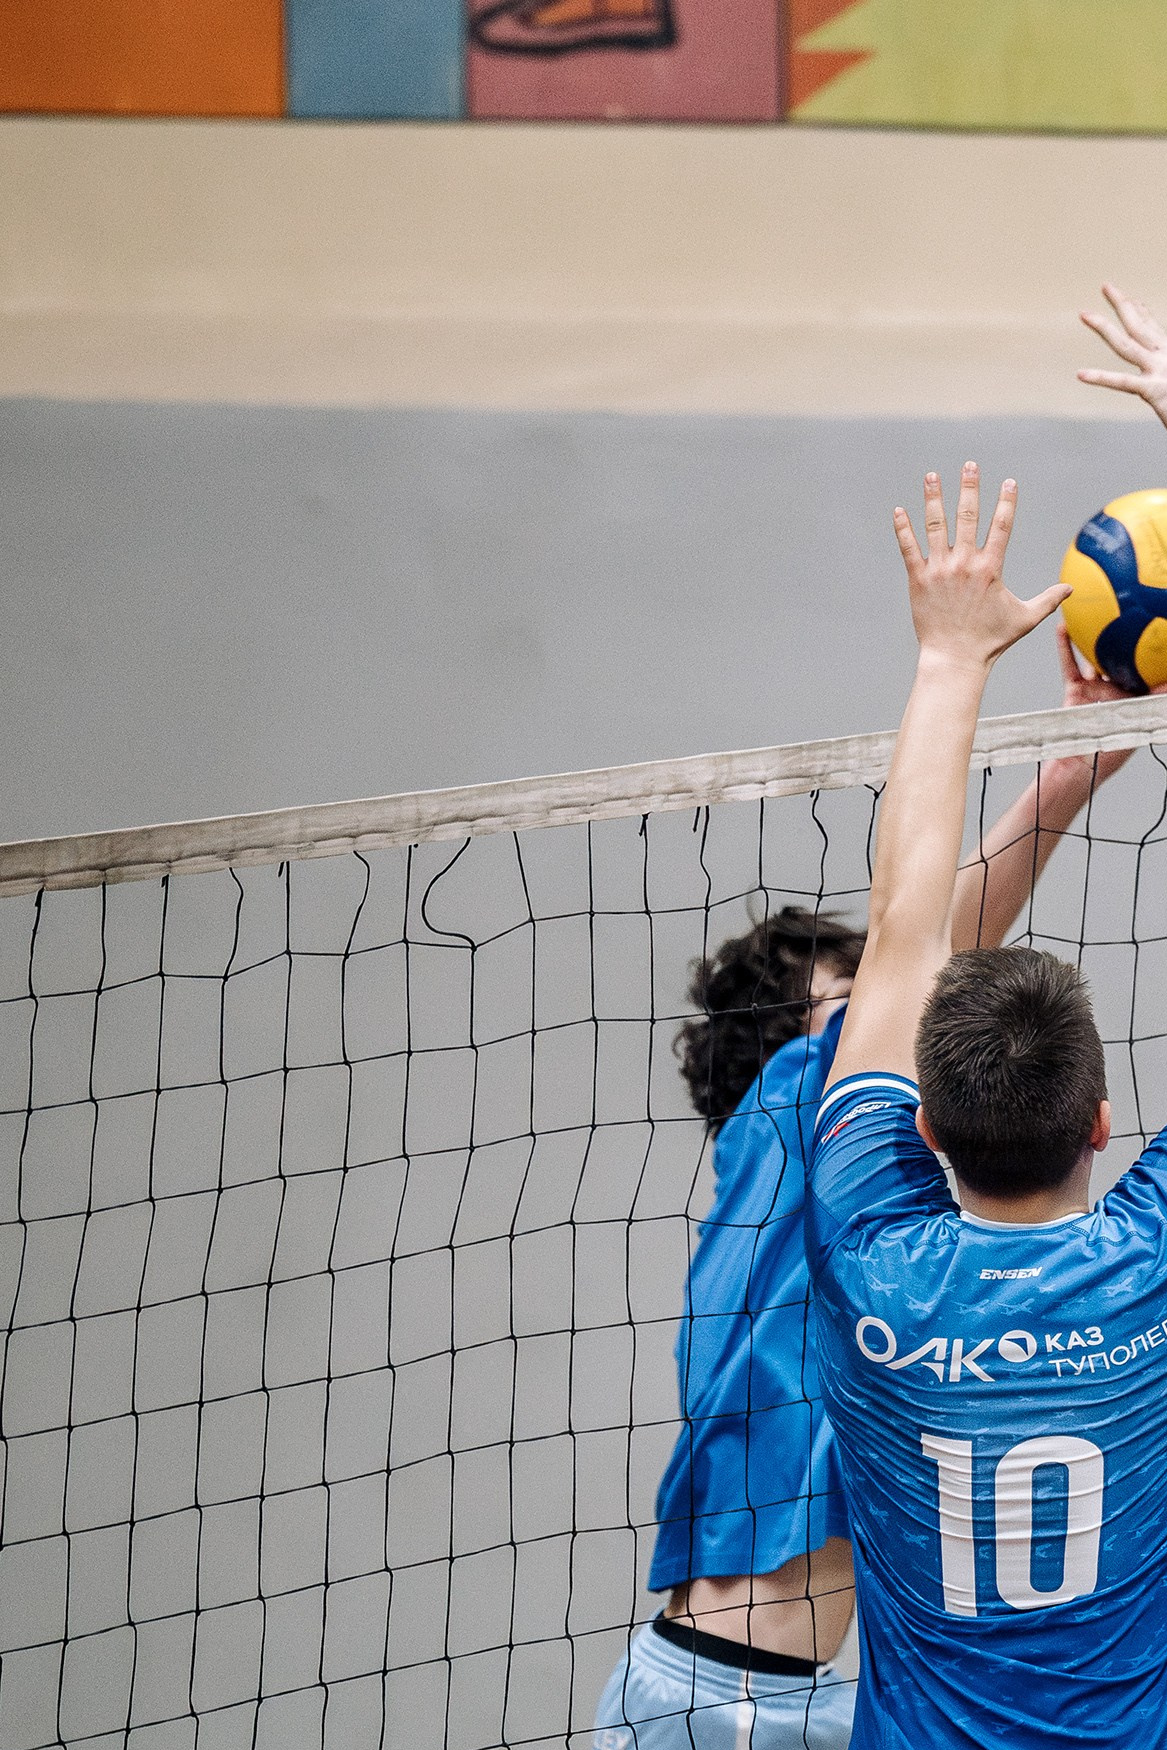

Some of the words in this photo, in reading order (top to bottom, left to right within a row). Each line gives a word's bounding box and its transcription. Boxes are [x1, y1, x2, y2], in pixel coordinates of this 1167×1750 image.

[980, 1267, 1042, 1280] ENSEN
[1045, 1327, 1105, 1352] КАЗ
[920, 1433, 1104, 1618] 10
